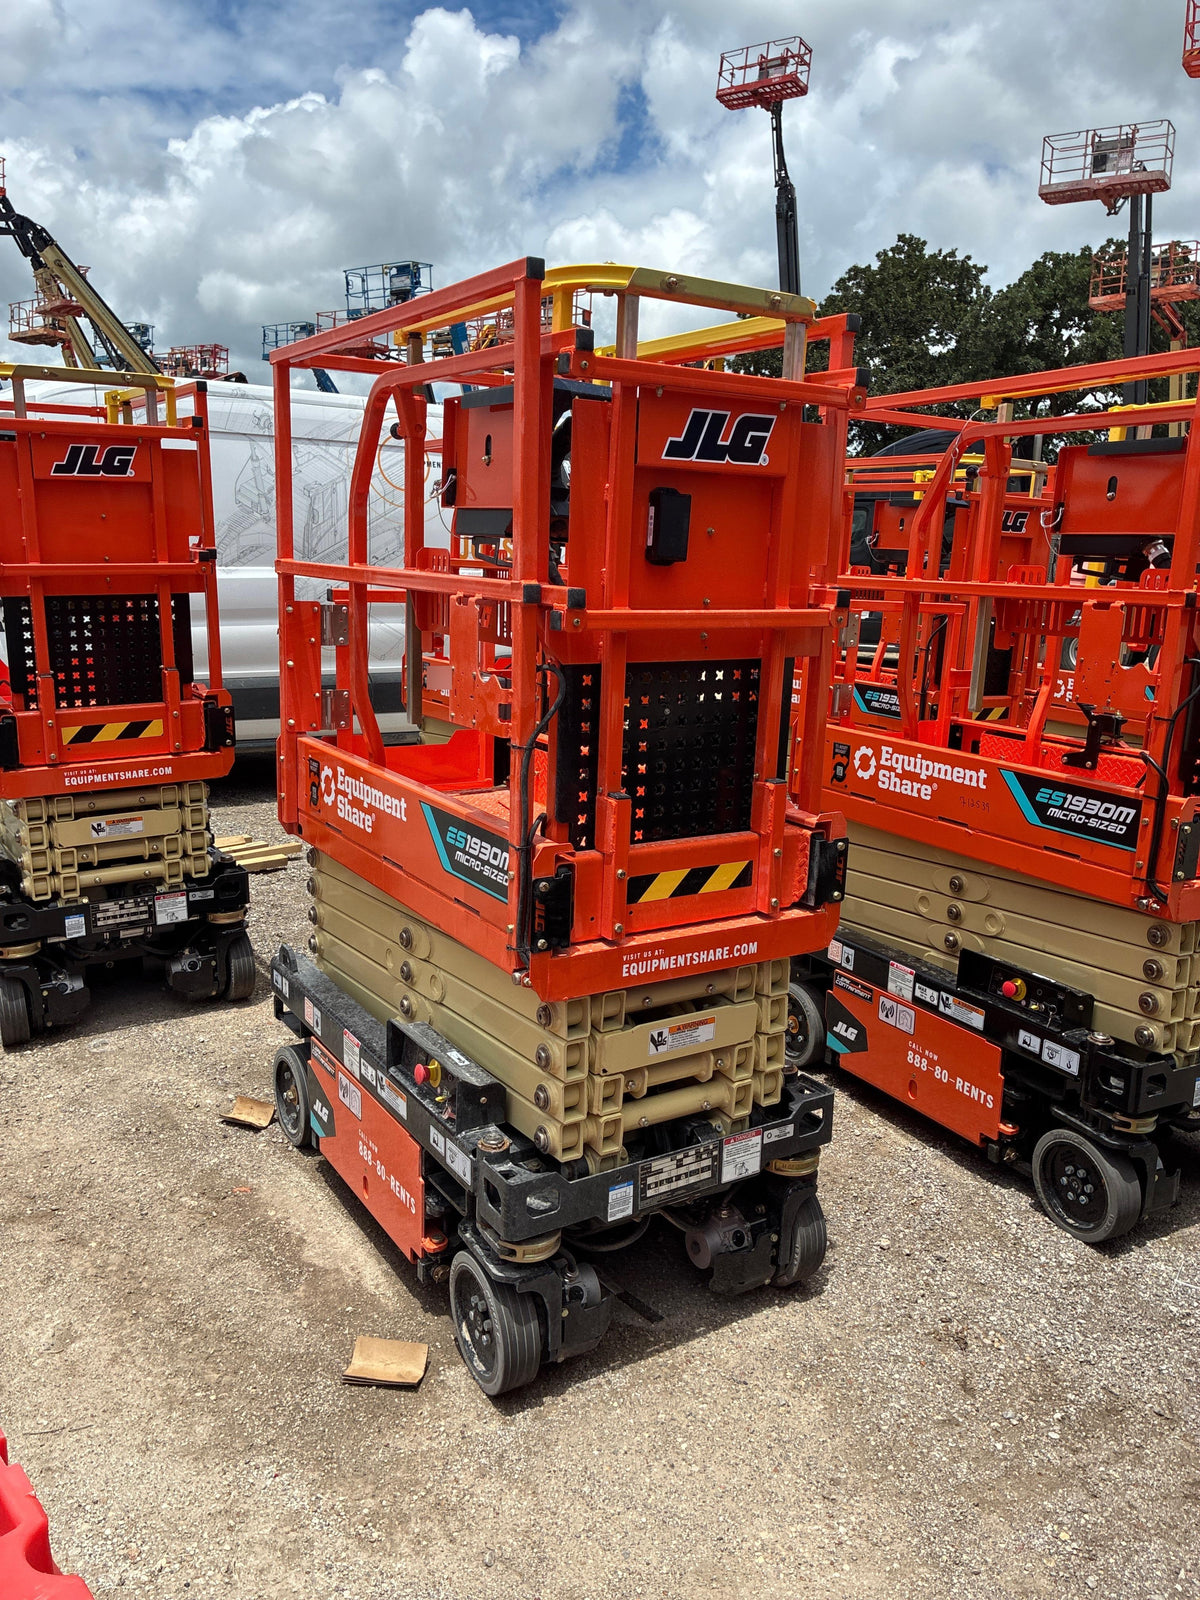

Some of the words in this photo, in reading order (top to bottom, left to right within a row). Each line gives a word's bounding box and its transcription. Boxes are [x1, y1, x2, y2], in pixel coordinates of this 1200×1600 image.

[661, 408, 777, 466] JLG
[50, 444, 138, 477] JLG
[64, 766, 173, 787] EQUIPMENTSHARE.COM
[879, 745, 988, 790] Equipment
[336, 765, 408, 823] Equipment
[877, 769, 932, 801] Share
[336, 794, 373, 834] Share
[1035, 787, 1137, 824] ES1930M
[1046, 807, 1127, 835] MICRO-SIZED
[622, 952, 641, 962] VISIT
[643, 950, 652, 958] US
[654, 948, 665, 956] AT:
[622, 941, 758, 978] EQUIPMENTSHARE.COM
[832, 1021, 858, 1041] JLG
[908, 1040, 923, 1053] CALL
[925, 1049, 938, 1061] NOW
[907, 1050, 994, 1109] 888-80-RENTS
[313, 1098, 329, 1123] JLG
[358, 1128, 368, 1144] CALL
[358, 1139, 416, 1215] 888-80-RENTS
